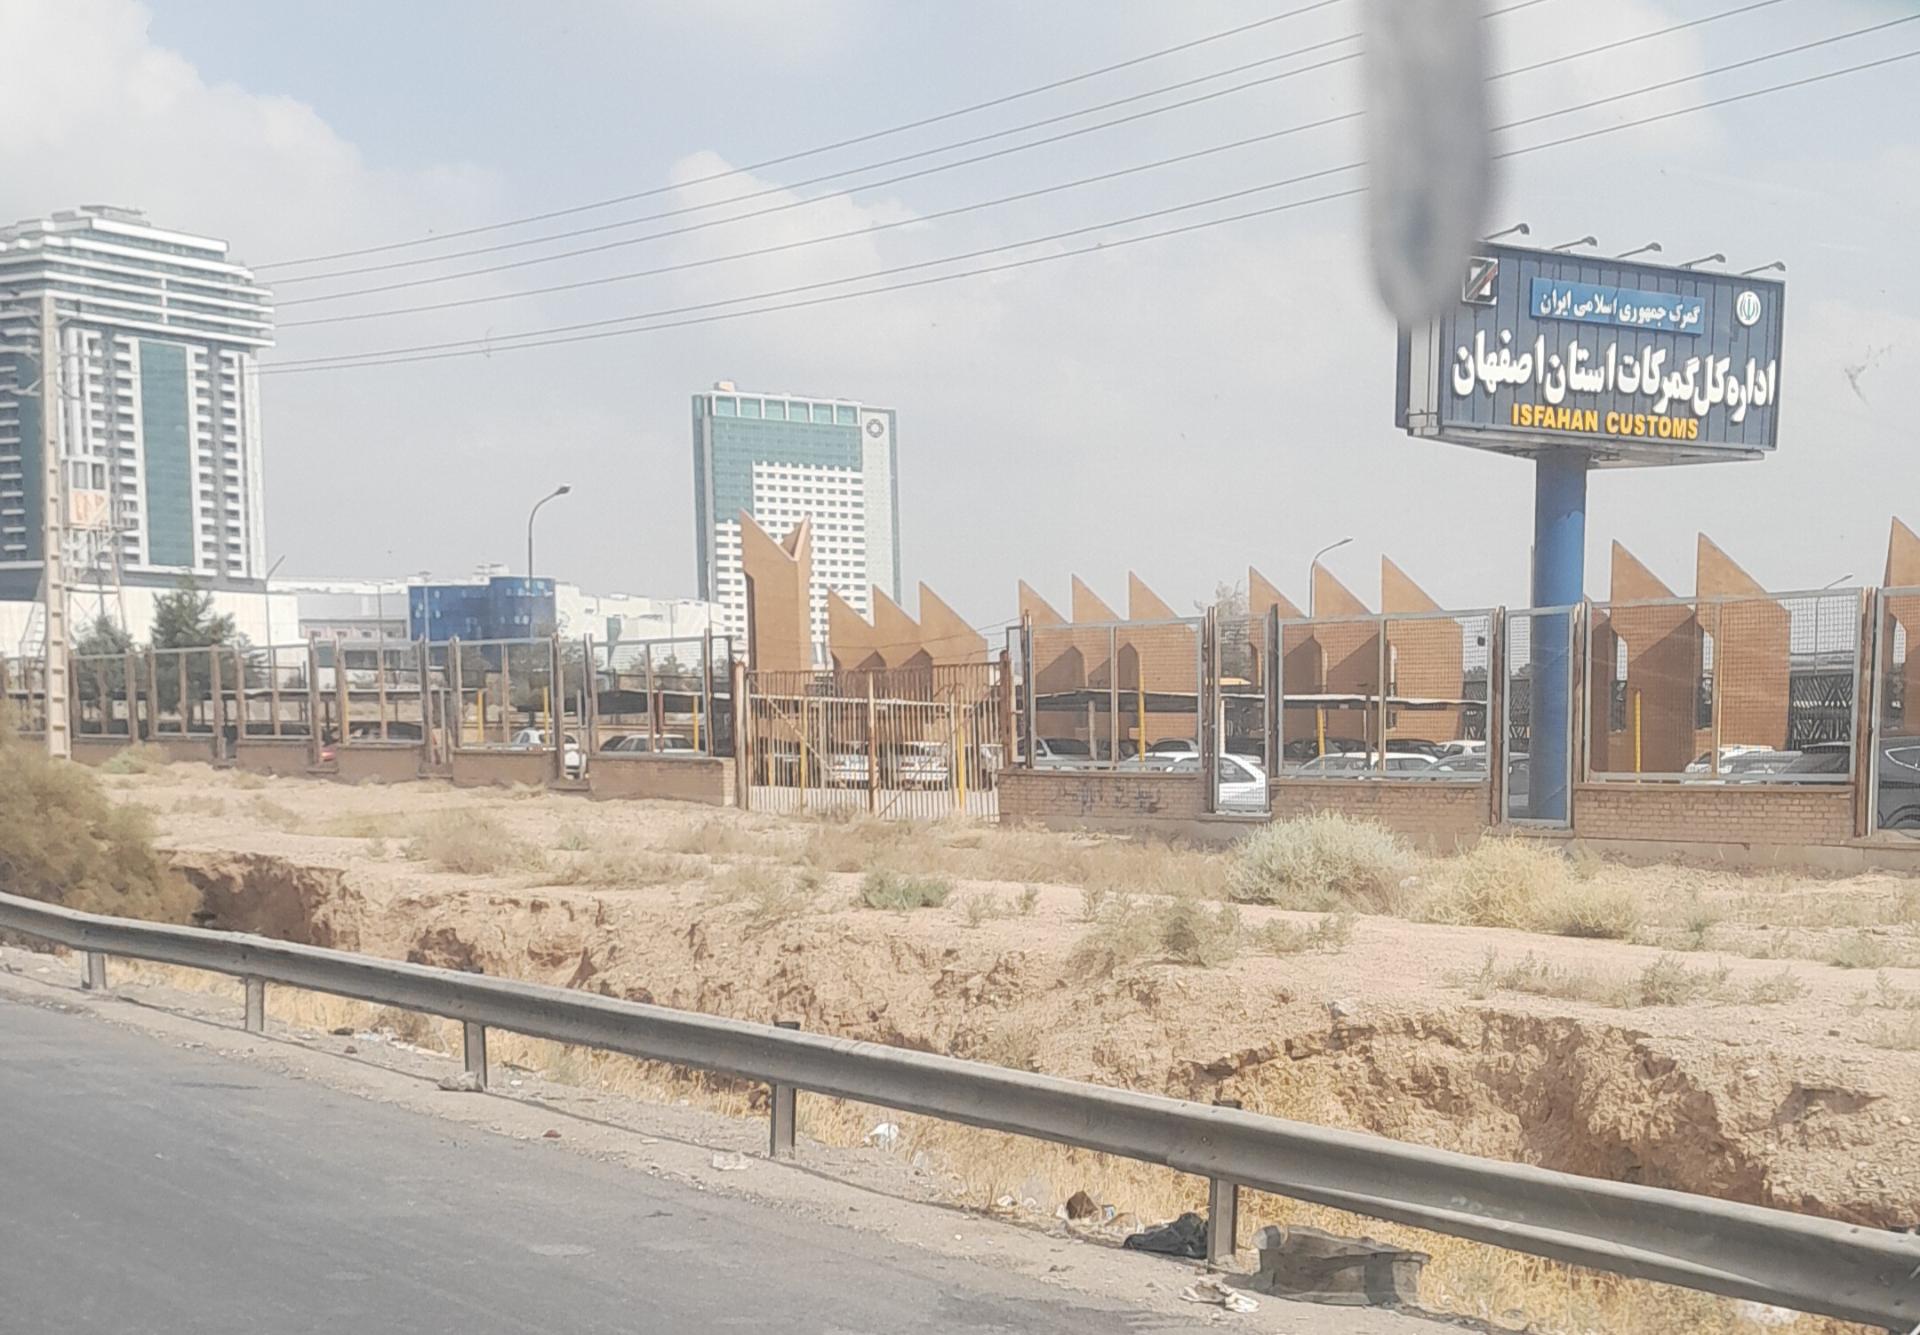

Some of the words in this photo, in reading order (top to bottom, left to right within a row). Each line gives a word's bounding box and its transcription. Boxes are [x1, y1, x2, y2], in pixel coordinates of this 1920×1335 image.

[1540, 288, 1572, 316] ایران
[1573, 293, 1618, 317] اسلامی
[1618, 302, 1667, 327] جمهوری
[1668, 303, 1701, 329] گمرک
[1453, 329, 1545, 396] اصفهان
[1544, 340, 1617, 404] استان
[1617, 345, 1700, 414] گمرکات
[1693, 354, 1731, 416] کل
[1727, 357, 1776, 422] اداره
[1512, 402, 1599, 432] ISFAHAN
[1605, 411, 1699, 440] CUSTOMS
